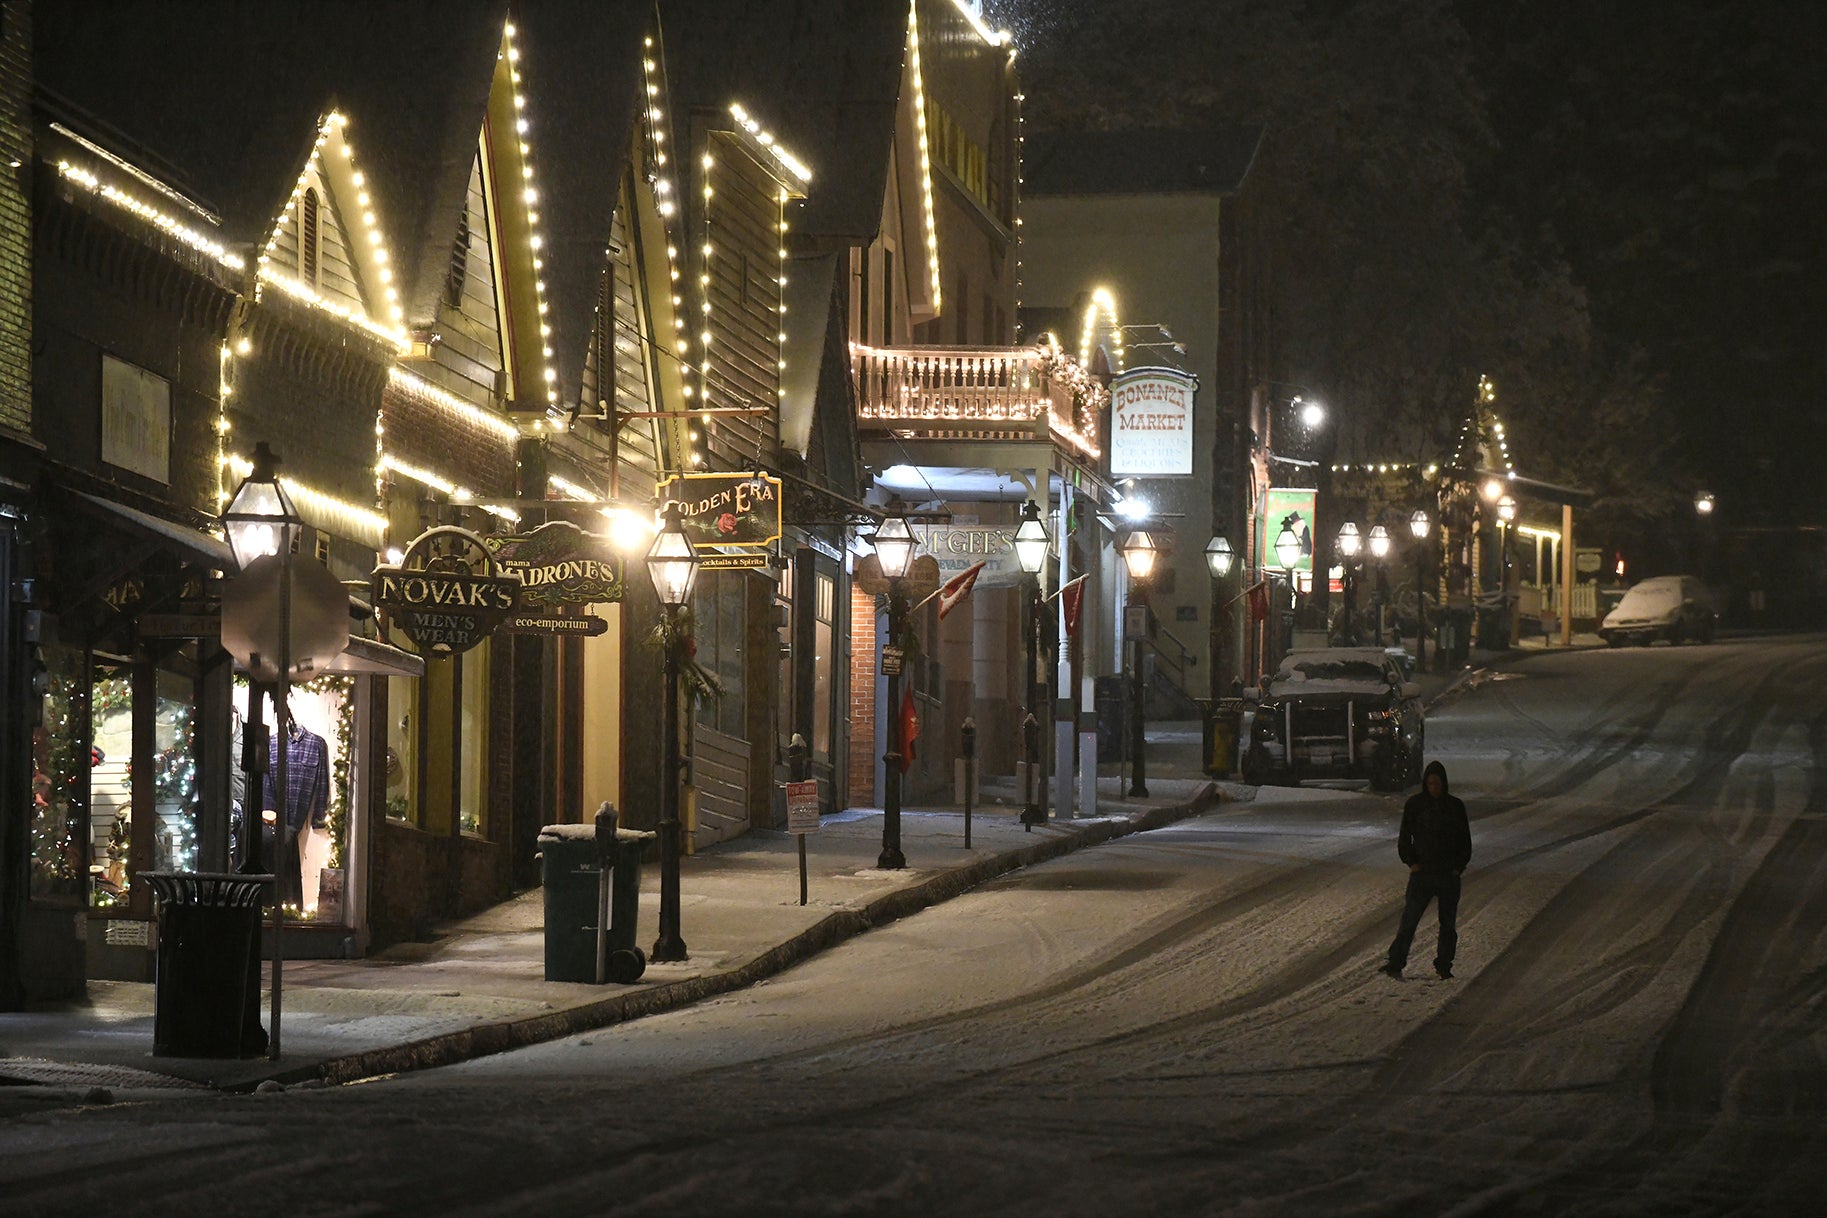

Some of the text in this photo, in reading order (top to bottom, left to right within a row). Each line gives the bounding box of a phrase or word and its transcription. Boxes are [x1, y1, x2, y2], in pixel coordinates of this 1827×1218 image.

[1117, 383, 1187, 413] BONANZA
[1119, 413, 1186, 430] MARKET
[735, 482, 774, 513] ERA
[702, 557, 733, 566] ocktails
[739, 556, 764, 566] Spirits
[380, 575, 513, 610] NOVAK'S
[413, 612, 475, 631] MEN'S
[515, 616, 589, 632] eco-emporium
[413, 628, 470, 644] WEAR
